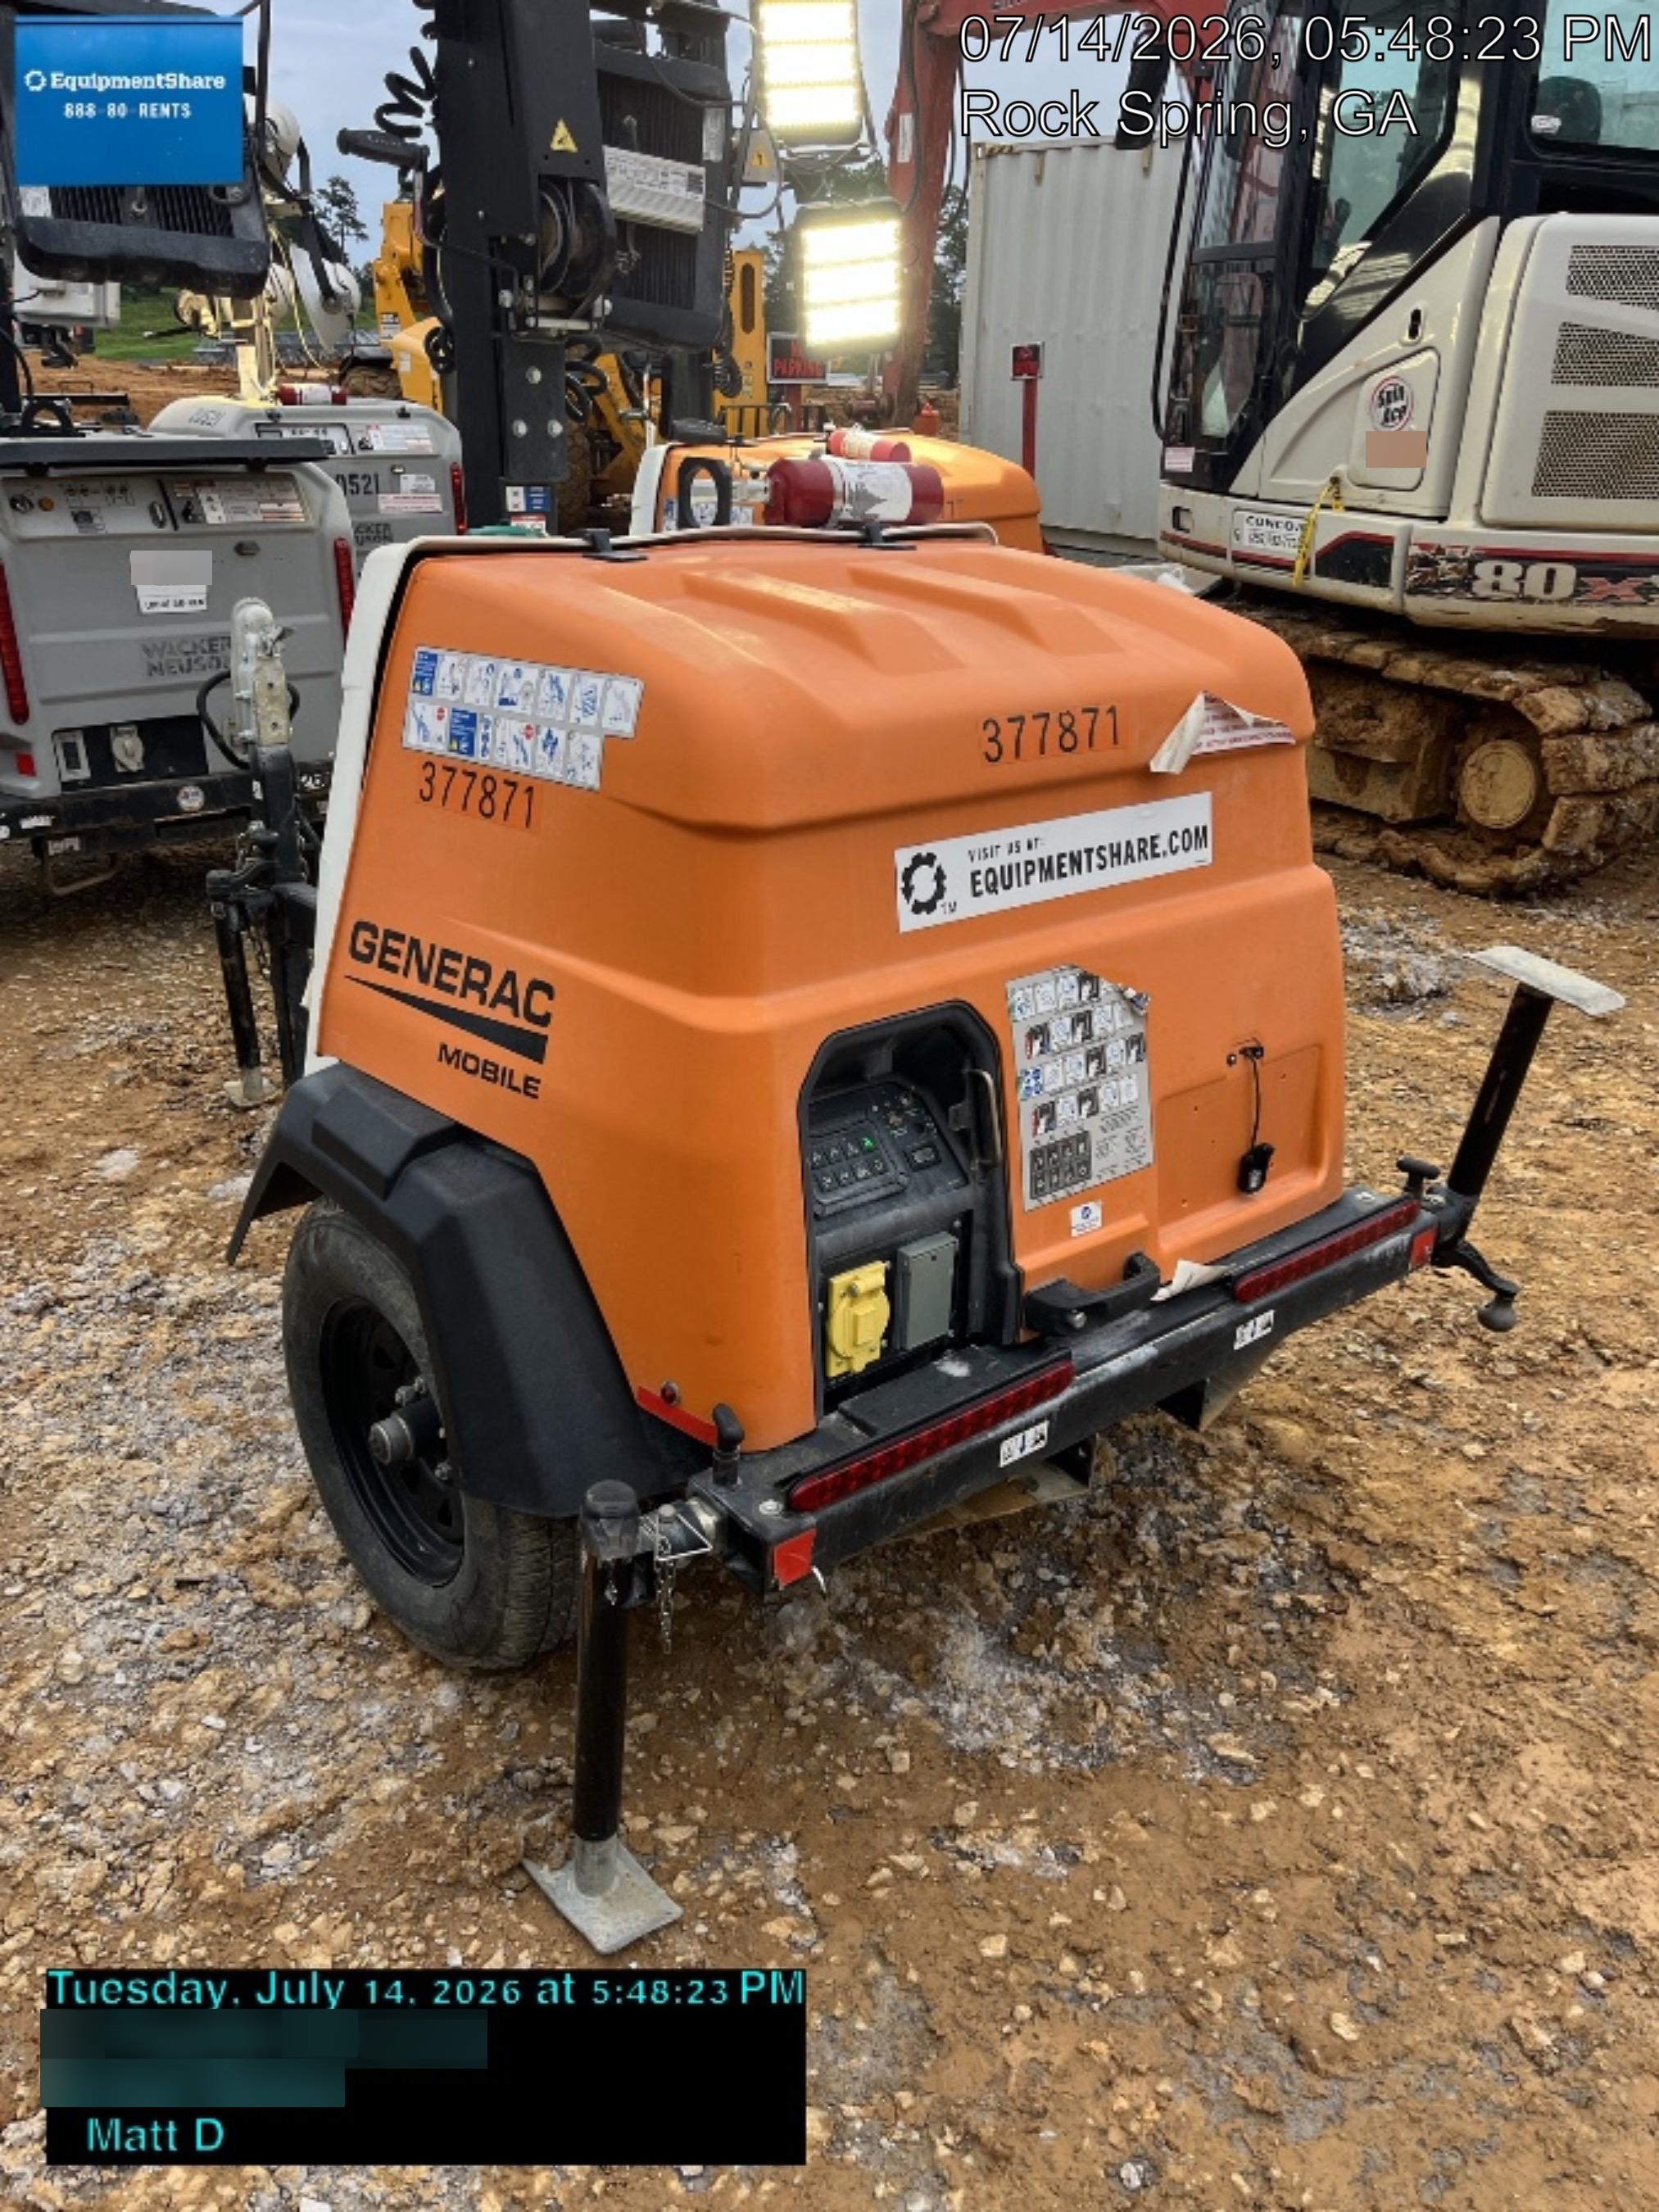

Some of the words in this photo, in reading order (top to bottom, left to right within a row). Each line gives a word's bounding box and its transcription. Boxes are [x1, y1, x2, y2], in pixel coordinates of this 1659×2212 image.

[50, 72, 226, 92] EquipmentShare
[1471, 559, 1577, 601] 80
[983, 705, 1118, 763] 377871
[419, 761, 533, 828] 377871
[968, 844, 1001, 863] VISIT
[970, 824, 1208, 898] EQUIPMENTSHARE.COM
[349, 920, 555, 1027] GENERAC
[437, 1042, 541, 1099] MOBILE
